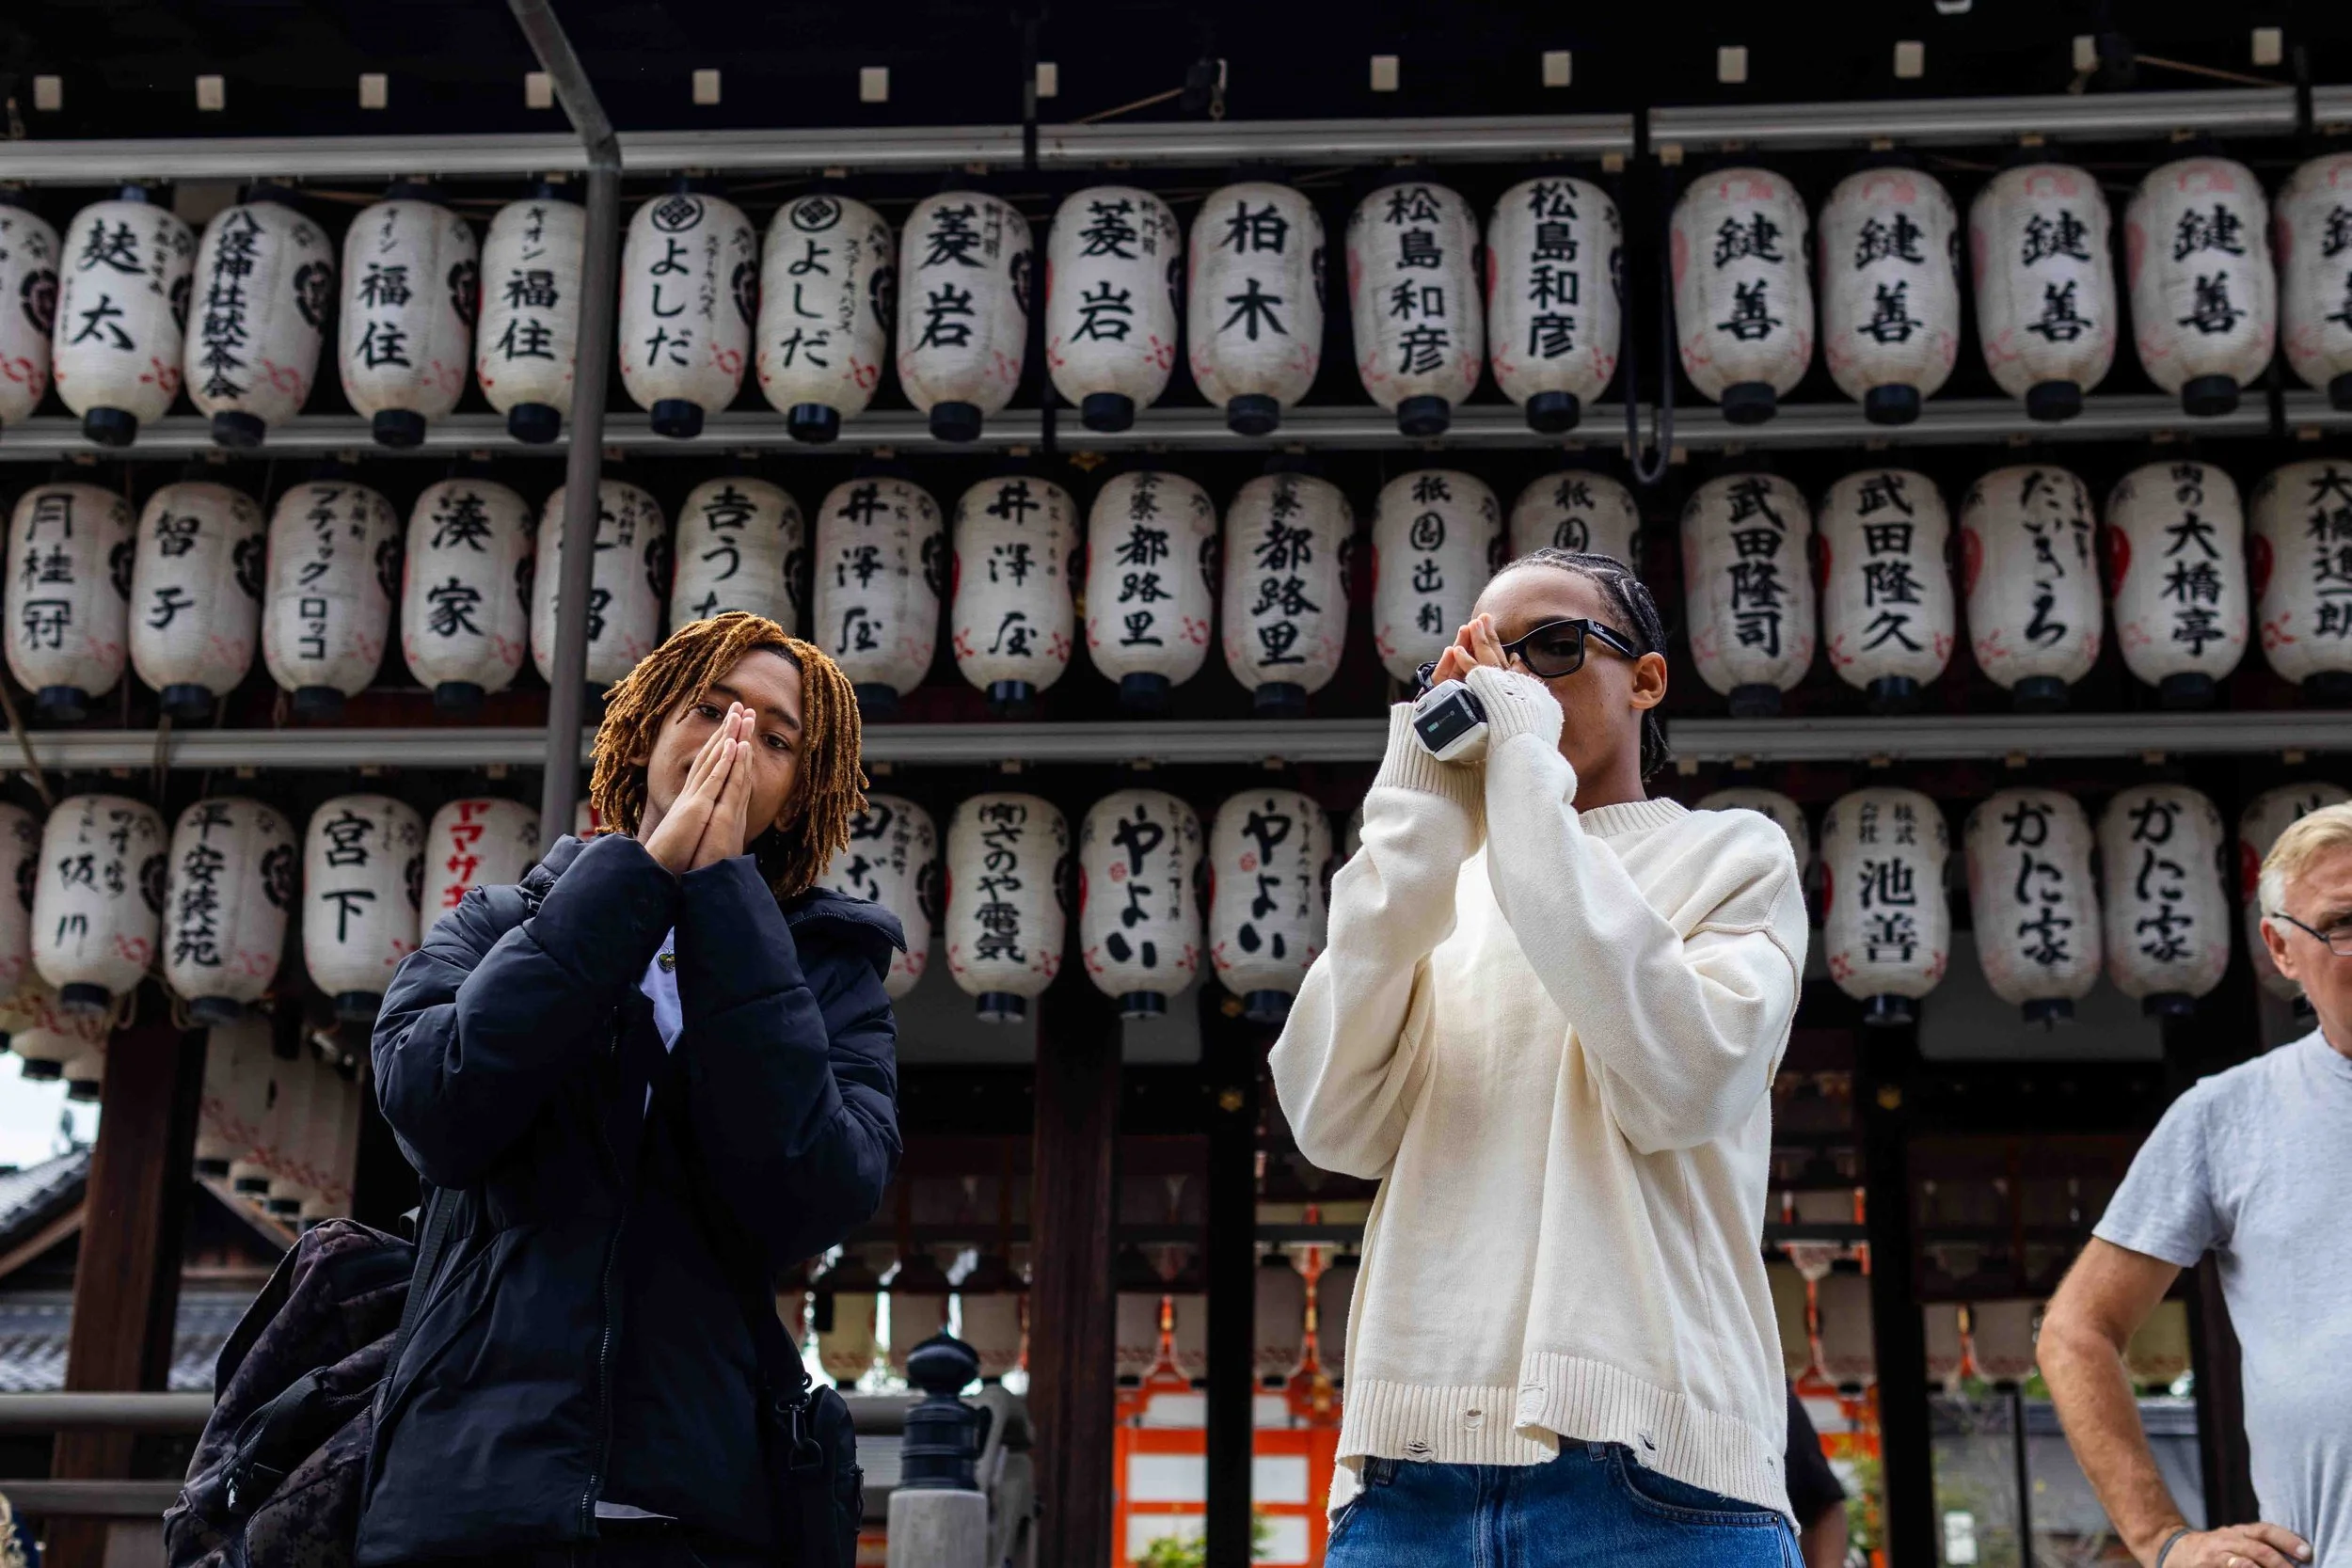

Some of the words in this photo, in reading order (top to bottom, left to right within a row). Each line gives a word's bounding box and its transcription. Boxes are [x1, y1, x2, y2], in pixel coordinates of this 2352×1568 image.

[645, 238, 692, 367] よしだ
[780, 238, 832, 368] よしだ
[913, 203, 988, 352] 菱岩
[1069, 198, 1139, 344] 菱岩
[1218, 199, 1288, 341] 柏木
[1385, 188, 1450, 375] 松島和彦
[1528, 182, 1581, 359] 松島和彦
[1713, 211, 1784, 341] 鍵善
[1854, 211, 1926, 345] 鍵善
[2021, 208, 2092, 343] 鍵善
[2173, 202, 2247, 336] 鍵善
[21, 493, 75, 650] 月桂冠
[1726, 477, 1788, 658] 武田隆司
[1857, 473, 1925, 654] 武田隆久
[322, 809, 375, 943] 宮下
[1106, 803, 1164, 968] やよい
[1238, 799, 1293, 959] やよい
